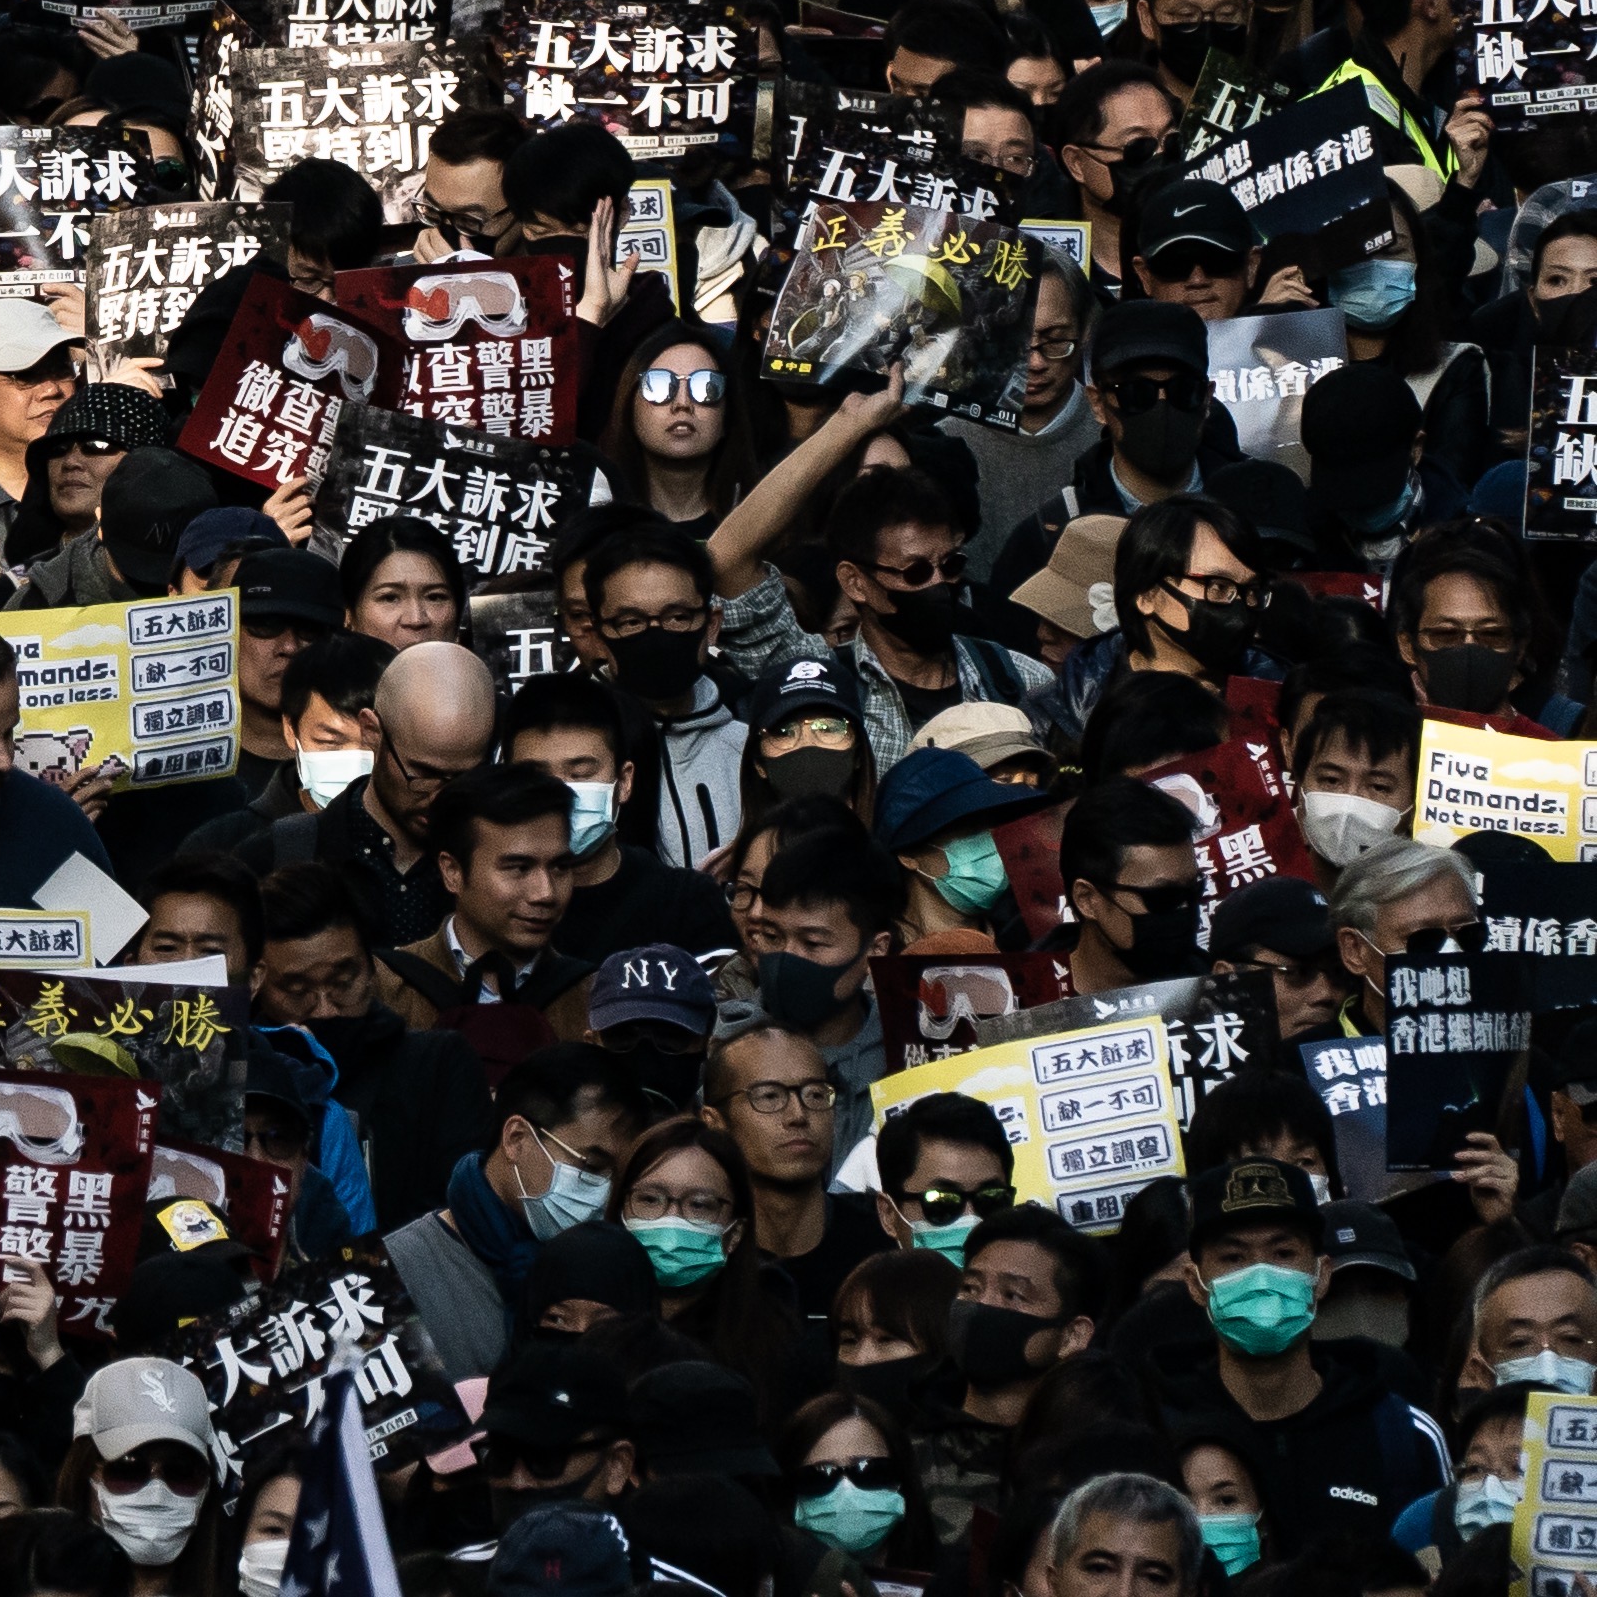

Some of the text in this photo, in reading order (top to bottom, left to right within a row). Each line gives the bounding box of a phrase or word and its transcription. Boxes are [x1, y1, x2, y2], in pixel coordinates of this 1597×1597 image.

[527, 21, 737, 72] 五大訴求
[260, 72, 459, 122] 五大訴求
[525, 74, 732, 126] 缺一不可
[812, 209, 1034, 289] 正義必勝
[357, 444, 562, 534] 五大訴求
[27, 693, 60, 708] one
[142, 701, 227, 729] 獨立調查
[1429, 752, 1489, 779] Five
[1427, 779, 1567, 809] Demands.
[1425, 808, 1465, 826] Not
[1470, 812, 1513, 830] one
[620, 959, 679, 990] NY
[1390, 964, 1472, 1006] 我哋想
[1062, 1136, 1162, 1172] 獨立調查
[1329, 1486, 1379, 1506] adidas
